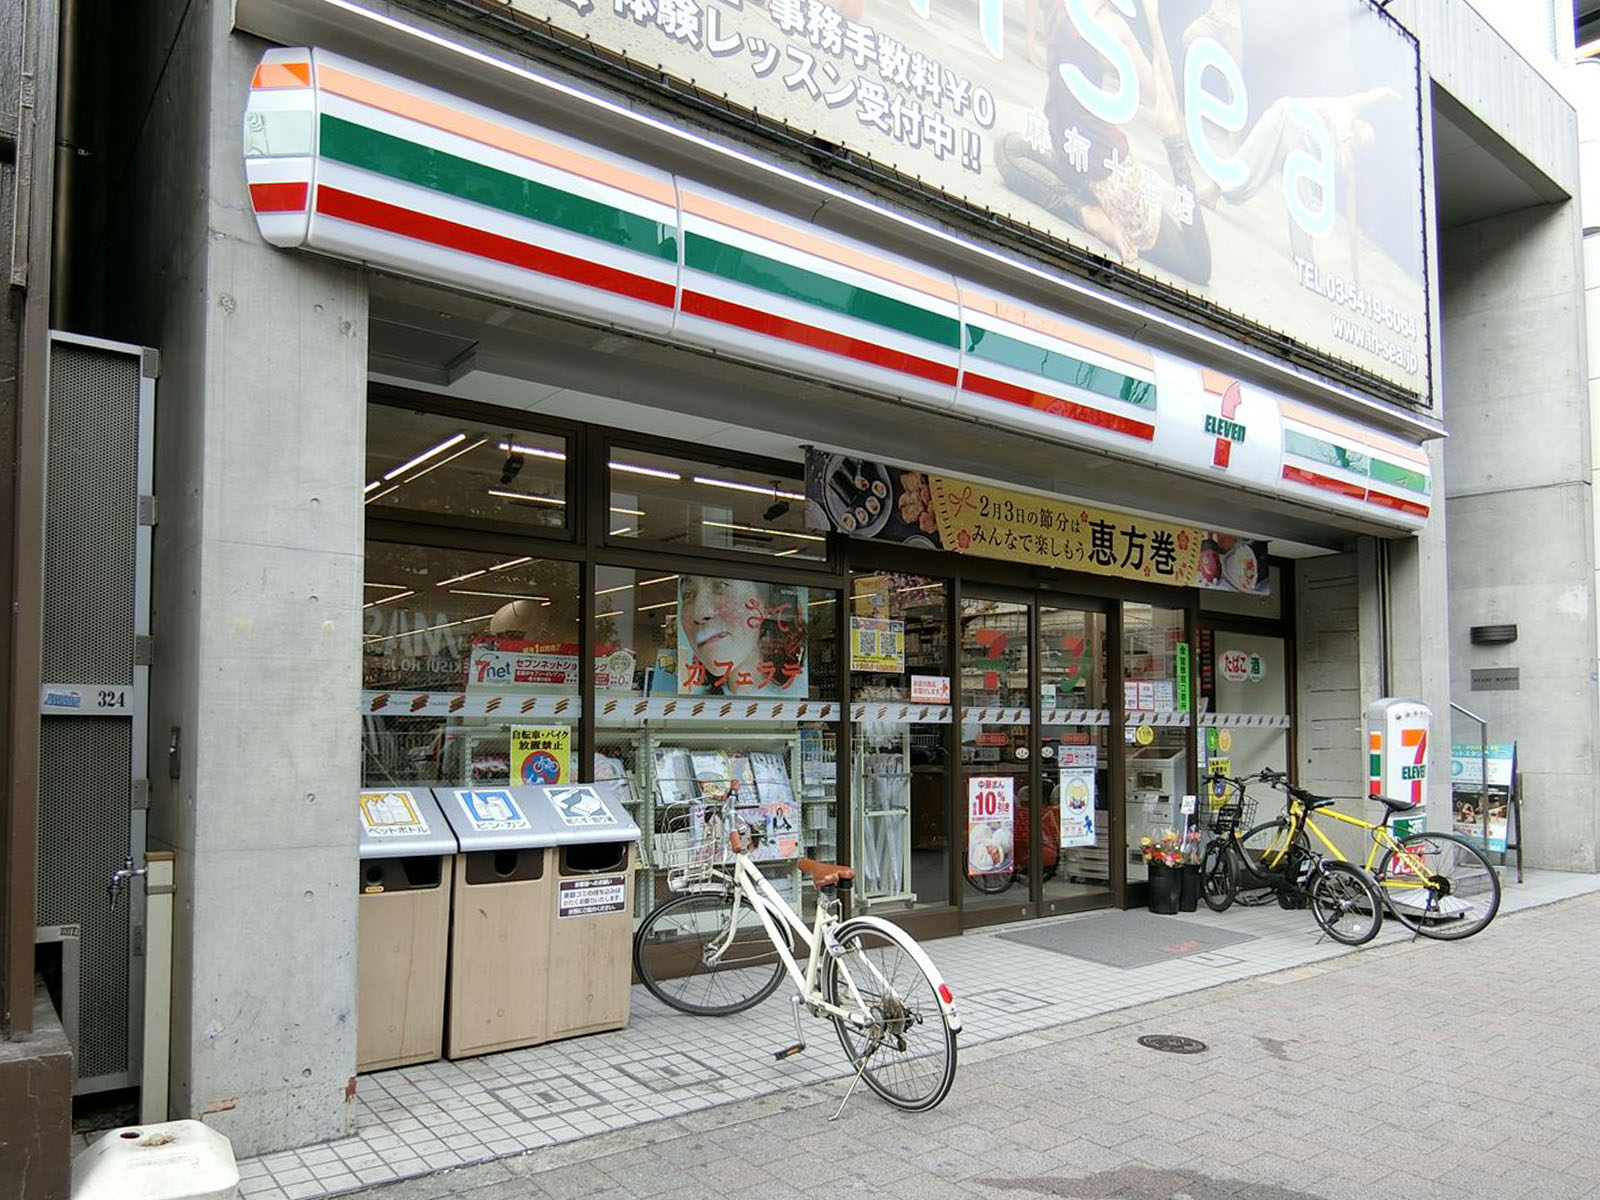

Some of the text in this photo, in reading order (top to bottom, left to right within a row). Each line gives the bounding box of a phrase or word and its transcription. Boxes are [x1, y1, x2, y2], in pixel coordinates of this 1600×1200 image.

[972, 525, 1084, 561] みんなで楽しもう
[980, 496, 1177, 576] 2月3日の節分は 恵方巻
[1224, 654, 1247, 673] たばこ
[683, 656, 802, 690] カフェラテ
[98, 691, 125, 707] 324
[512, 730, 569, 740] 自転車・バイク
[519, 741, 563, 750] 放置禁止
[1401, 765, 1426, 780] ELEVE
[368, 826, 428, 835] ペットボトル
[476, 820, 527, 830] ビン・カン
